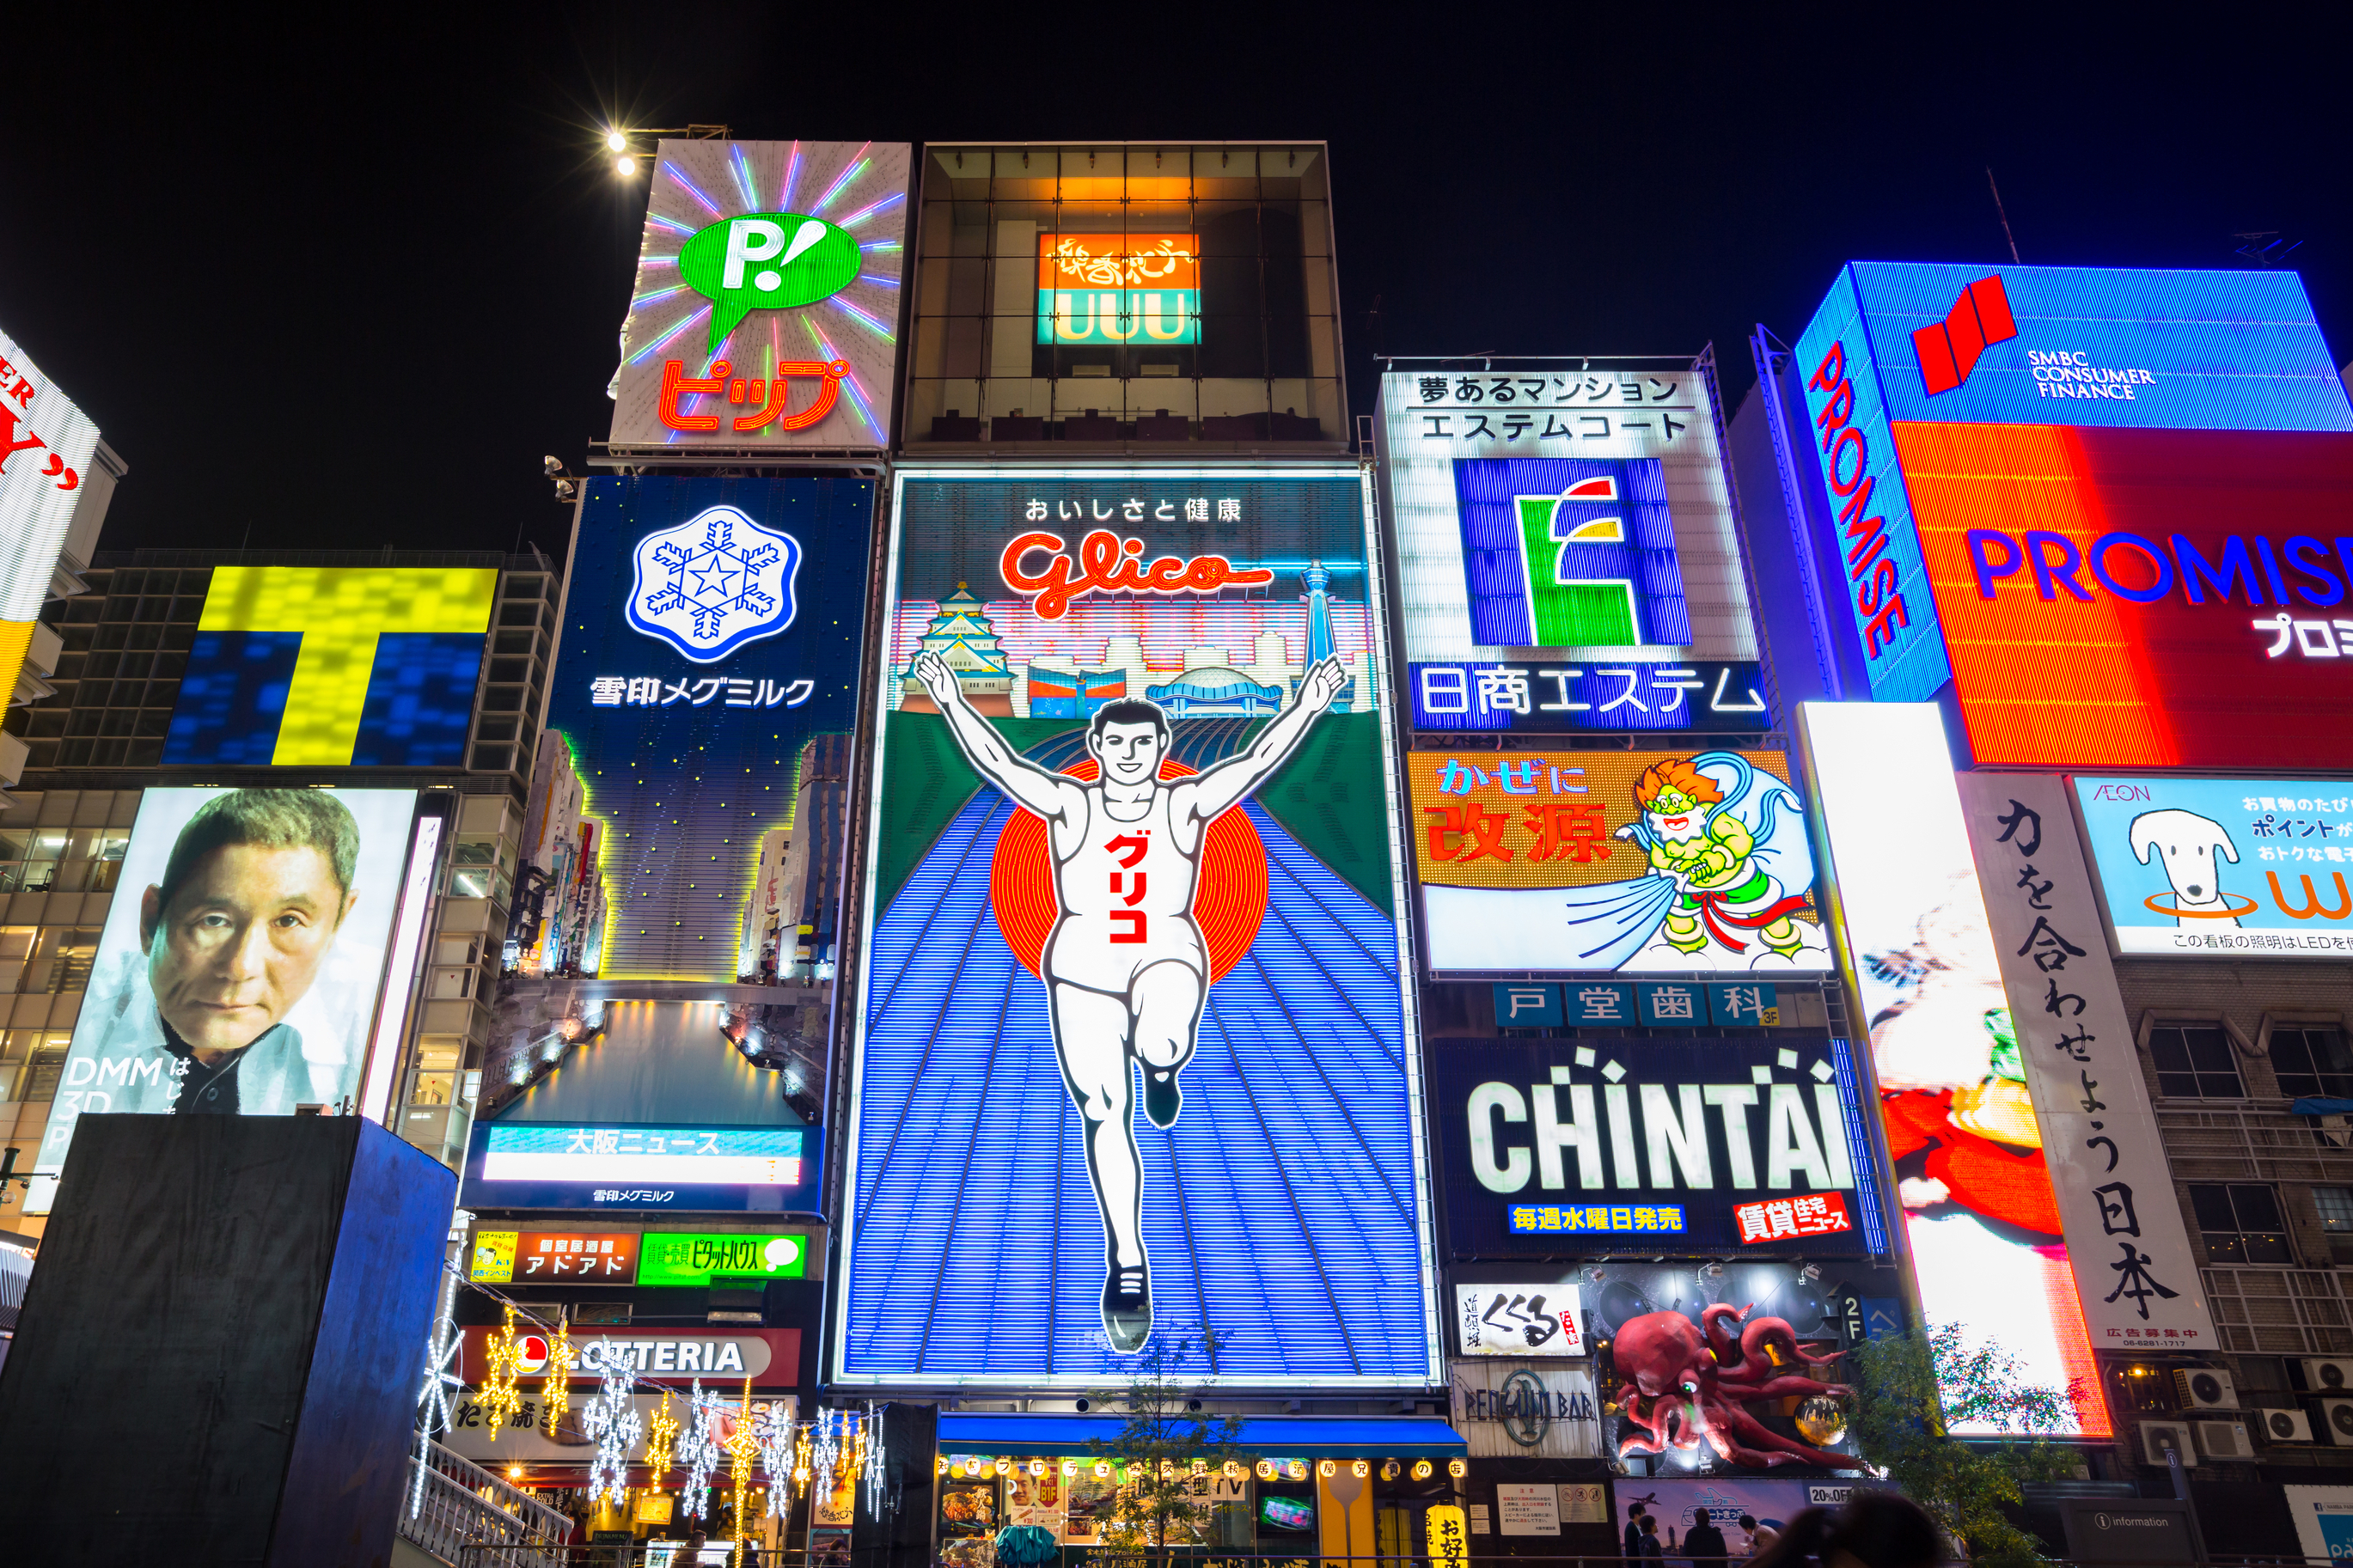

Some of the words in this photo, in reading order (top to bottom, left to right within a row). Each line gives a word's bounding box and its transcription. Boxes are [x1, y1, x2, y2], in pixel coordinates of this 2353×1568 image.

[2028, 350, 2089, 368] SMBC
[1418, 376, 1678, 404] 夢あるマンション
[2032, 366, 2157, 386] CONSUMER
[658, 360, 852, 433] ピップ
[2037, 382, 2136, 401] FINANCE
[1422, 413, 1686, 442] エステムコート
[1026, 498, 1242, 523] おいしさと健康
[1809, 340, 1908, 660] PROMISE
[590, 676, 815, 709] 雪印メグミルク
[1421, 666, 1766, 714] 日商エステム
[1437, 759, 1589, 796] かぜに
[2242, 797, 2353, 813] お買物のたび
[1424, 803, 1613, 863] 改源
[1104, 829, 1152, 944] グリコ
[1508, 985, 1763, 1020] 戸堂歯科
[1763, 1011, 1778, 1025] 3F
[65, 1058, 163, 1086] DMM
[1996, 799, 2181, 1321] 力を合わせよう日本
[565, 1128, 720, 1156] 大阪ニュース
[1467, 1074, 1855, 1193] CHINTAI
[593, 1189, 675, 1203] 雪印メグミルク
[1513, 1206, 1682, 1231] 毎週水曜日発売
[540, 1239, 614, 1254] 個室居酒屋
[693, 1239, 757, 1270] ピタットハウス
[526, 1255, 625, 1275] アドアド
[1482, 1293, 1560, 1347] くくる
[2106, 1328, 2198, 1338] 広告募集中
[1556, 1388, 1597, 1422] BAR
[1041, 1486, 1056, 1501] B1F
[2112, 1516, 2169, 1528] information
